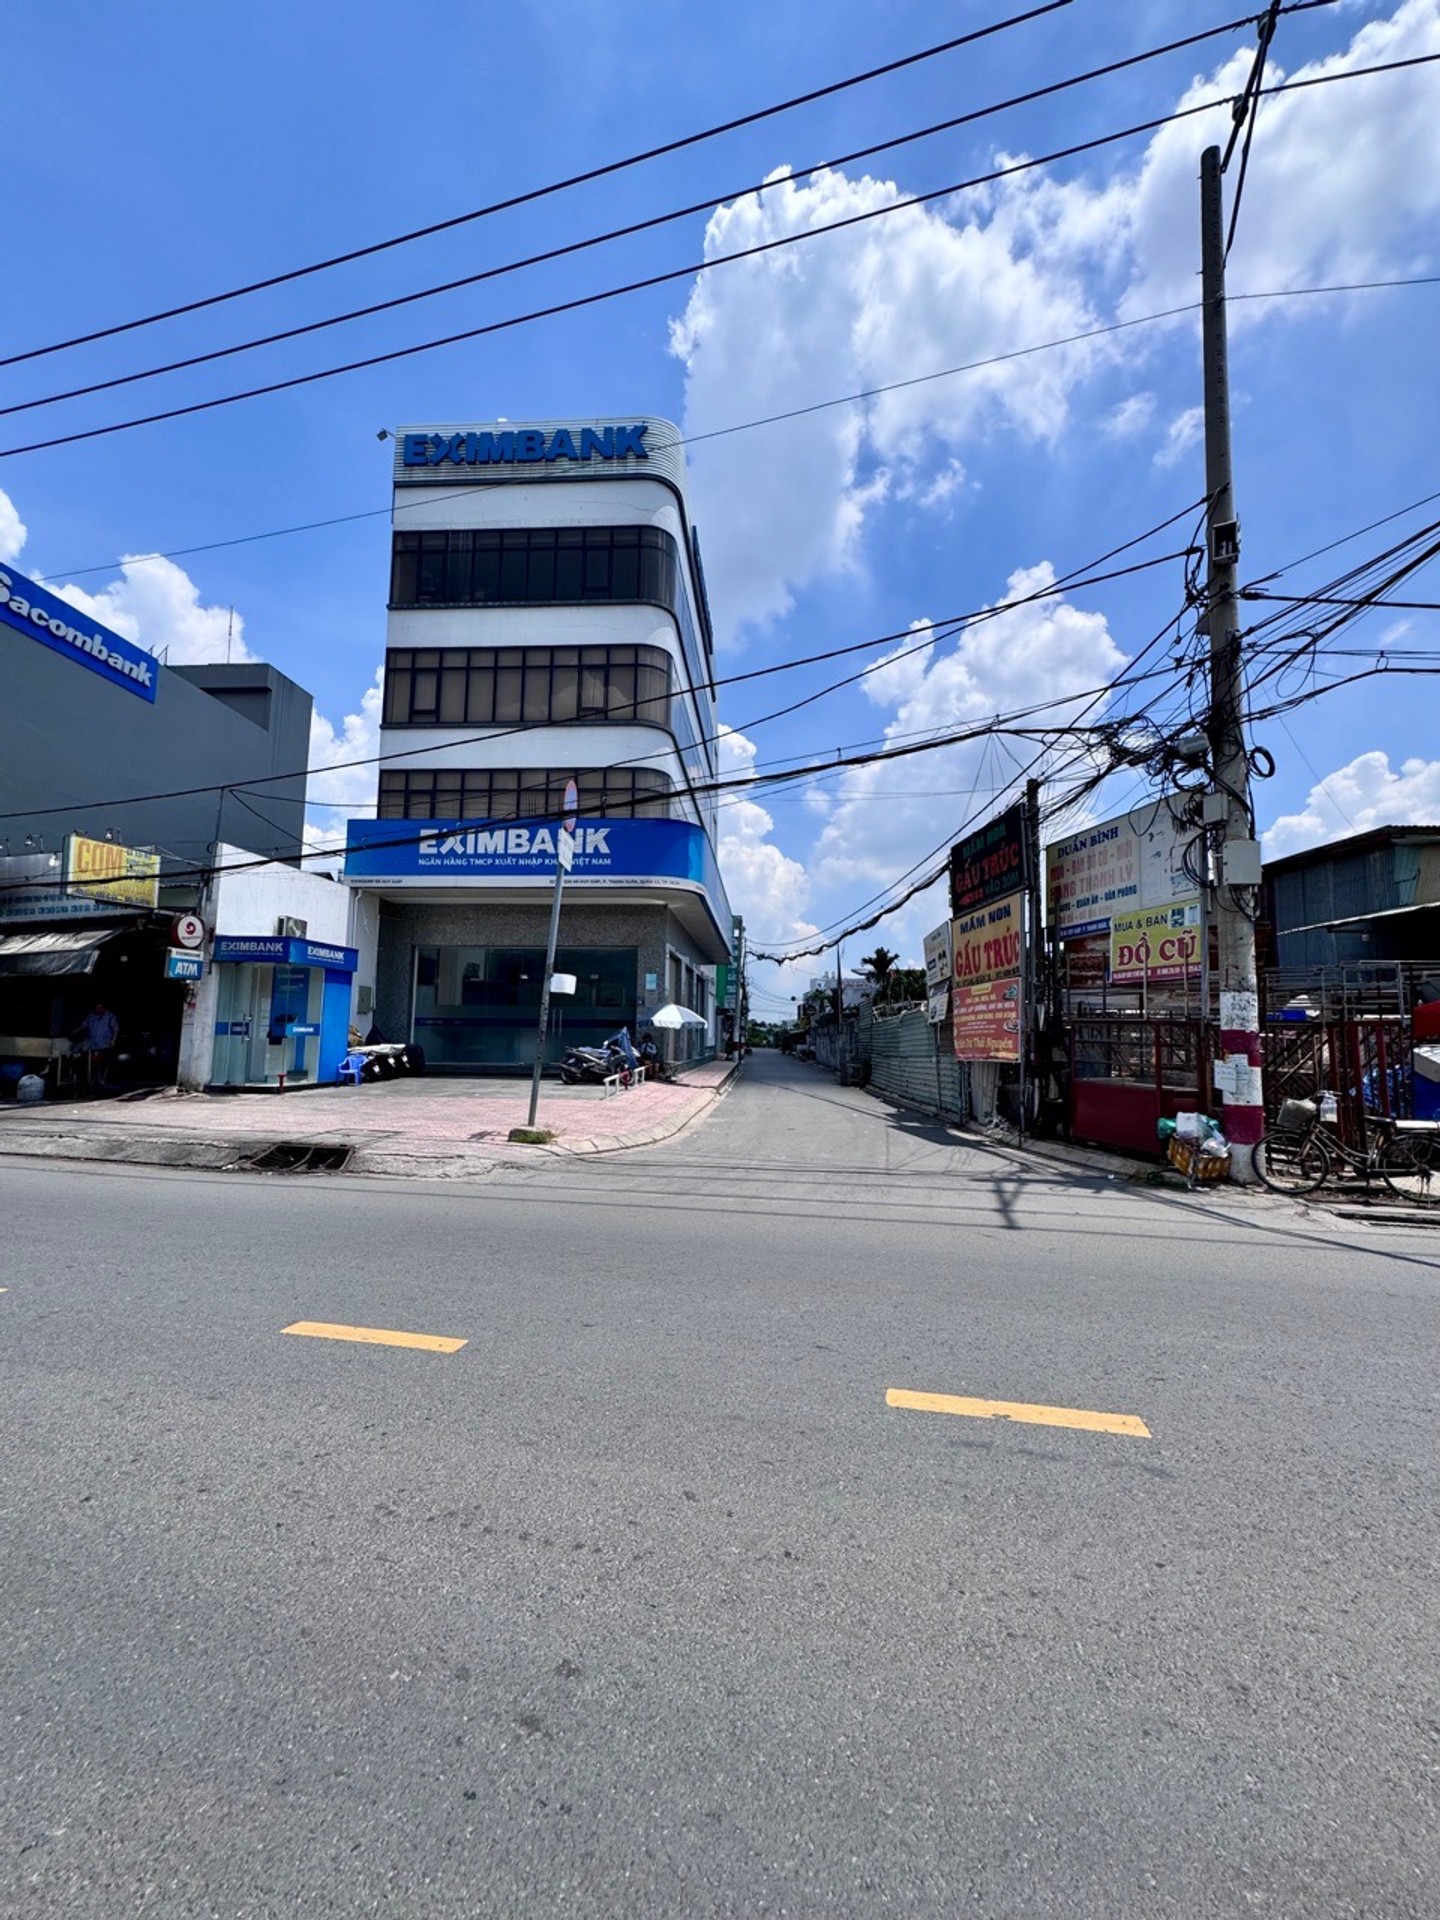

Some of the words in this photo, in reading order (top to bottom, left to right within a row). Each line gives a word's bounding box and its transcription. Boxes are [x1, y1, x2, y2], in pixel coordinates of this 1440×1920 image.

[404, 425, 649, 466] EXIMBANK
[418, 828, 612, 855] EXIMBANK
[418, 857, 441, 866] NGÂN
[444, 856, 468, 866] HÀNG
[470, 858, 494, 866] TMCP
[495, 856, 517, 866] XUẤT
[518, 857, 543, 867] NHẬP
[591, 857, 612, 866] NAM
[982, 842, 1020, 881] TRÚC
[988, 903, 1011, 924] NON
[1114, 920, 1133, 933] MUA
[1136, 919, 1143, 930] &
[220, 941, 284, 952] EXIMBANK
[307, 946, 345, 960] EXIMBANK
[955, 939, 981, 978] GẤU
[984, 928, 1020, 972] TRÚC
[1118, 932, 1151, 967] ĐỒ
[1159, 928, 1197, 961] CŨ
[175, 962, 198, 977] ATM
